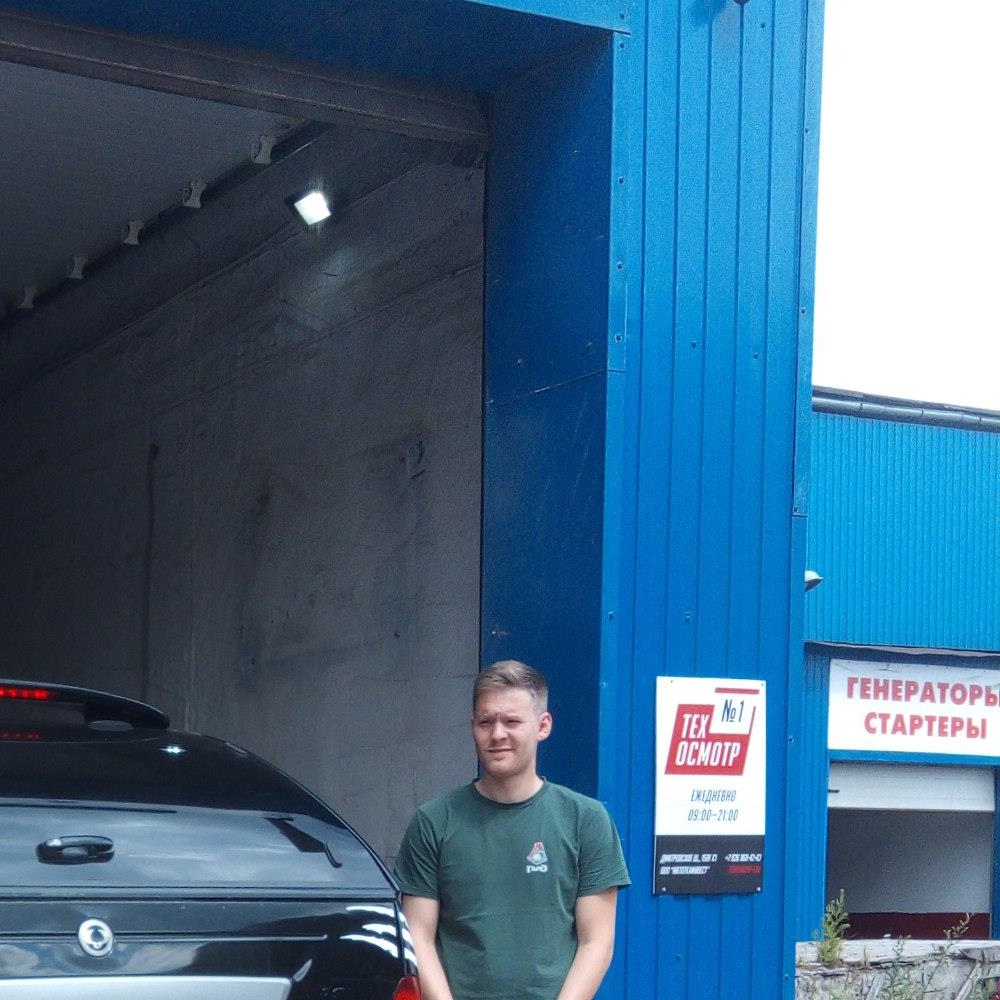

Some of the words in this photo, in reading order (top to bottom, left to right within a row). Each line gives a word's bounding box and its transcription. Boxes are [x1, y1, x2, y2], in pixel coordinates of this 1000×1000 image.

[847, 677, 1000, 707] ГЕНЕРАТОРЫ
[680, 713, 710, 739] ТЕХ
[864, 711, 987, 739] СТАРТЕРЫ
[675, 741, 741, 767] ОСМОТР
[690, 789, 737, 804] ЕЖЕДНЕВНО
